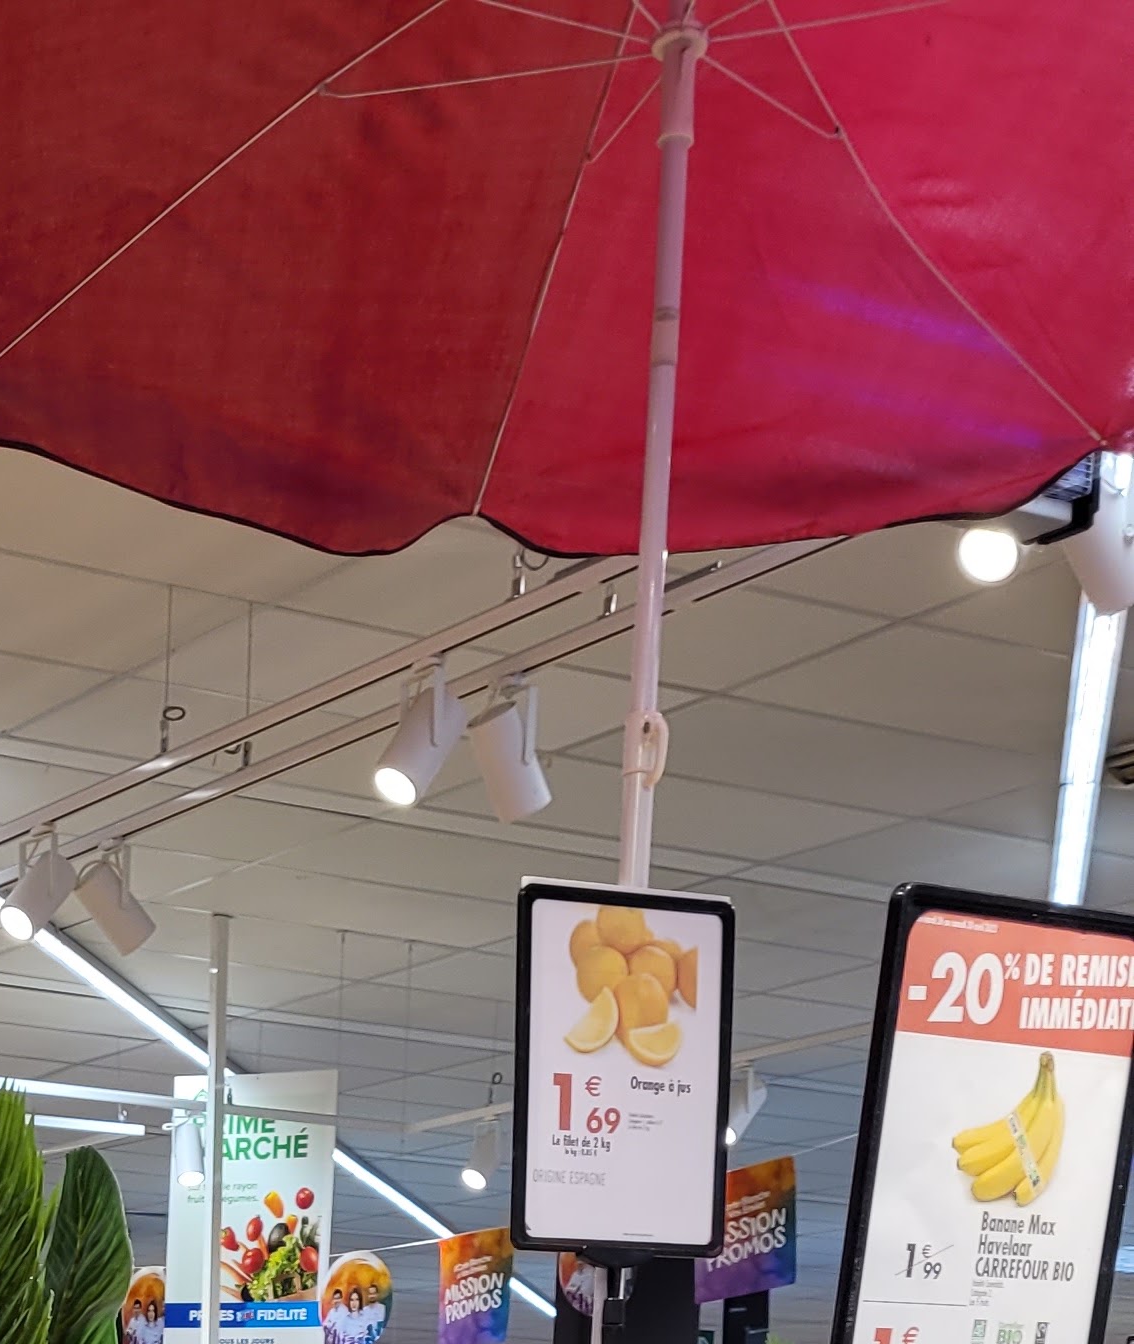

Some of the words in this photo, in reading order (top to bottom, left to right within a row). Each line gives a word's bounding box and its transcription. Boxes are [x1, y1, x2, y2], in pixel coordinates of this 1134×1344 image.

[1024, 953, 1055, 986] DE
[1019, 989, 1134, 1030] IMMÉDIAT
[630, 1076, 665, 1095] Orange
[677, 1080, 691, 1096] jus
[586, 1107, 621, 1134] 69
[222, 1127, 309, 1160] ARCHÉ
[581, 1137, 591, 1148] de
[593, 1137, 599, 1149] 2
[601, 1137, 611, 1151] kg
[533, 1168, 566, 1184] ORIGINE
[569, 1170, 606, 1186] ESPAGNE
[724, 1207, 786, 1243] SSION
[981, 1211, 1024, 1233] Banane
[1028, 1214, 1056, 1236] Max
[978, 1234, 1032, 1257] Havelaar
[975, 1257, 1048, 1281] CARREFOUR
[1052, 1261, 1074, 1282] BIO
[445, 1273, 504, 1305] MISSION
[256, 1308, 307, 1321] FIDÉLITÉ
[445, 1289, 502, 1324] PROMOS
[996, 1329, 1022, 1344] BIO
